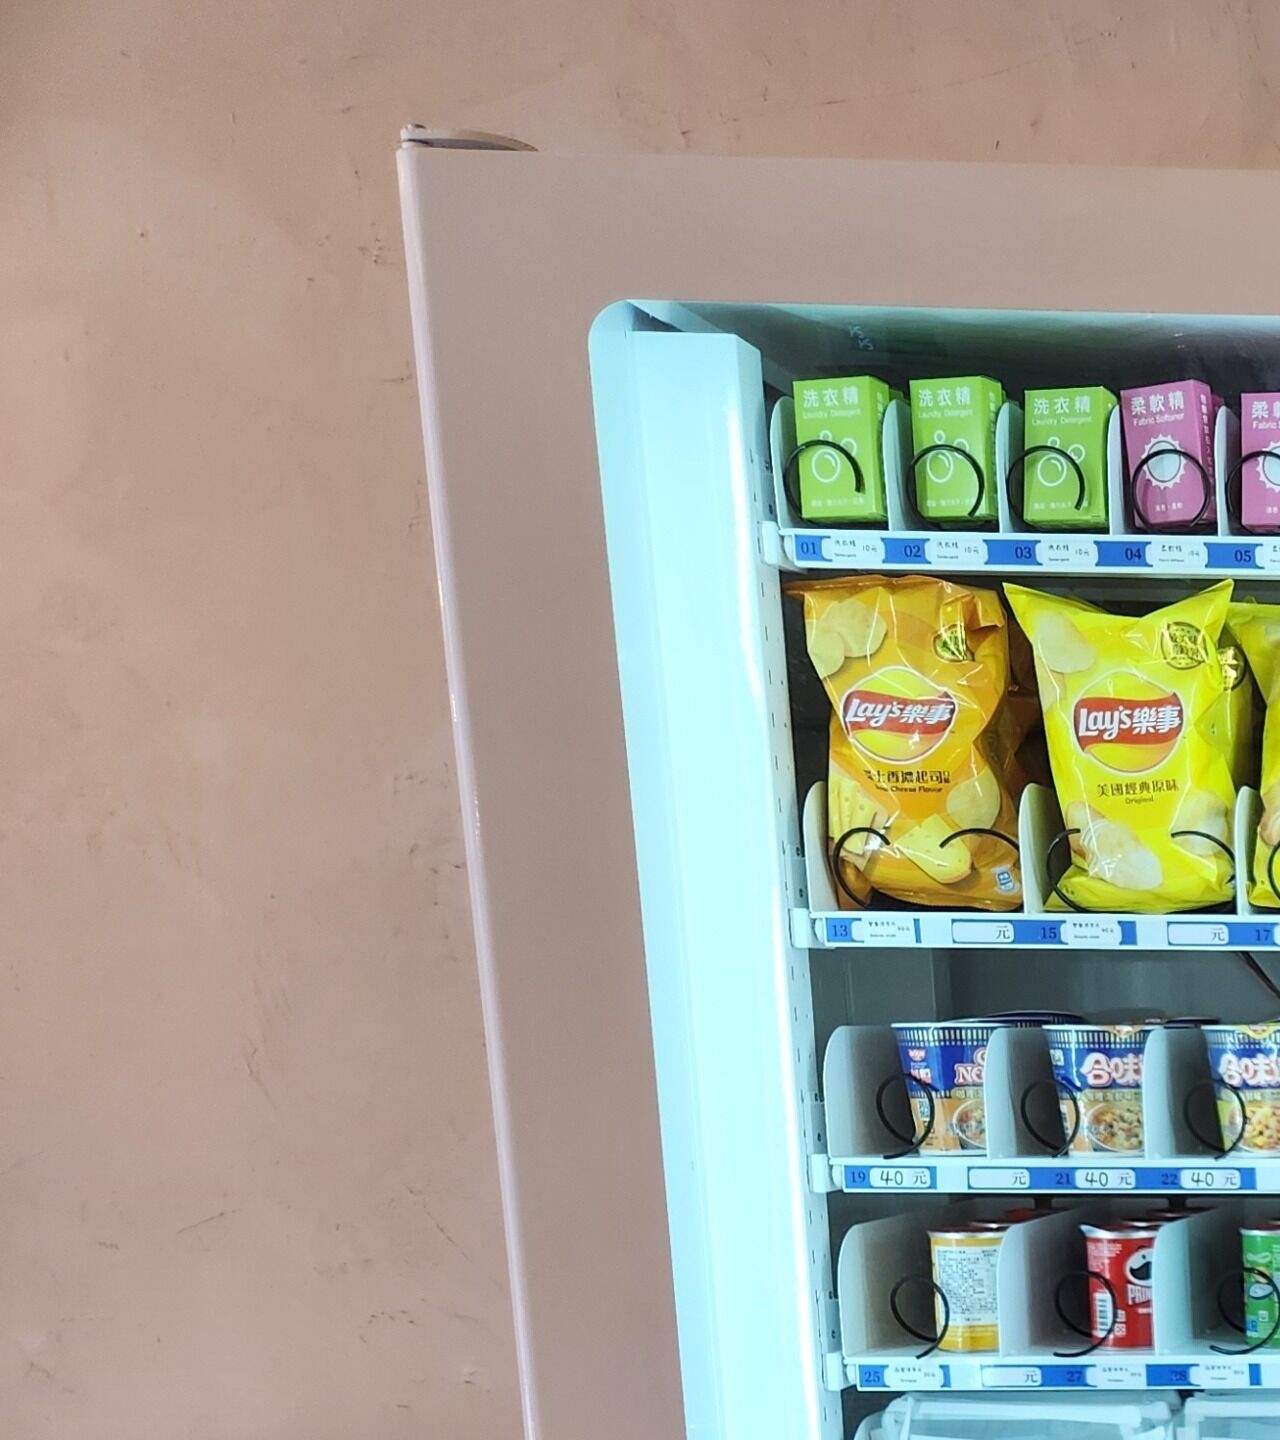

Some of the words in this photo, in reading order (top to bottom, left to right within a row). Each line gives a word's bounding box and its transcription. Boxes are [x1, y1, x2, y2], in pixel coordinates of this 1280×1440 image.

[803, 386, 859, 409] 洗衣精
[918, 386, 972, 408] 洗衣精
[1130, 390, 1186, 416] 柔軟精
[1033, 395, 1091, 416] 洗衣精
[800, 542, 817, 556] 01
[903, 544, 923, 558] 02
[1014, 546, 1034, 560] 03
[1124, 547, 1143, 561] 04
[1234, 549, 1252, 563] 05
[831, 924, 849, 938] 13
[995, 925, 1011, 940] 元
[1040, 926, 1058, 940] 15
[1210, 927, 1226, 942] 元
[1254, 928, 1272, 943] 17
[850, 1170, 867, 1184] 19
[879, 1169, 904, 1186] 40
[911, 1171, 928, 1186] 元
[1011, 1171, 1027, 1186] 元
[1055, 1172, 1072, 1186] 21
[1084, 1170, 1109, 1187] 40
[1116, 1171, 1133, 1186] 元
[1160, 1173, 1178, 1186] 22
[1190, 1170, 1215, 1187] 40
[1223, 1171, 1238, 1186] 元
[1023, 1370, 1039, 1384] 元
